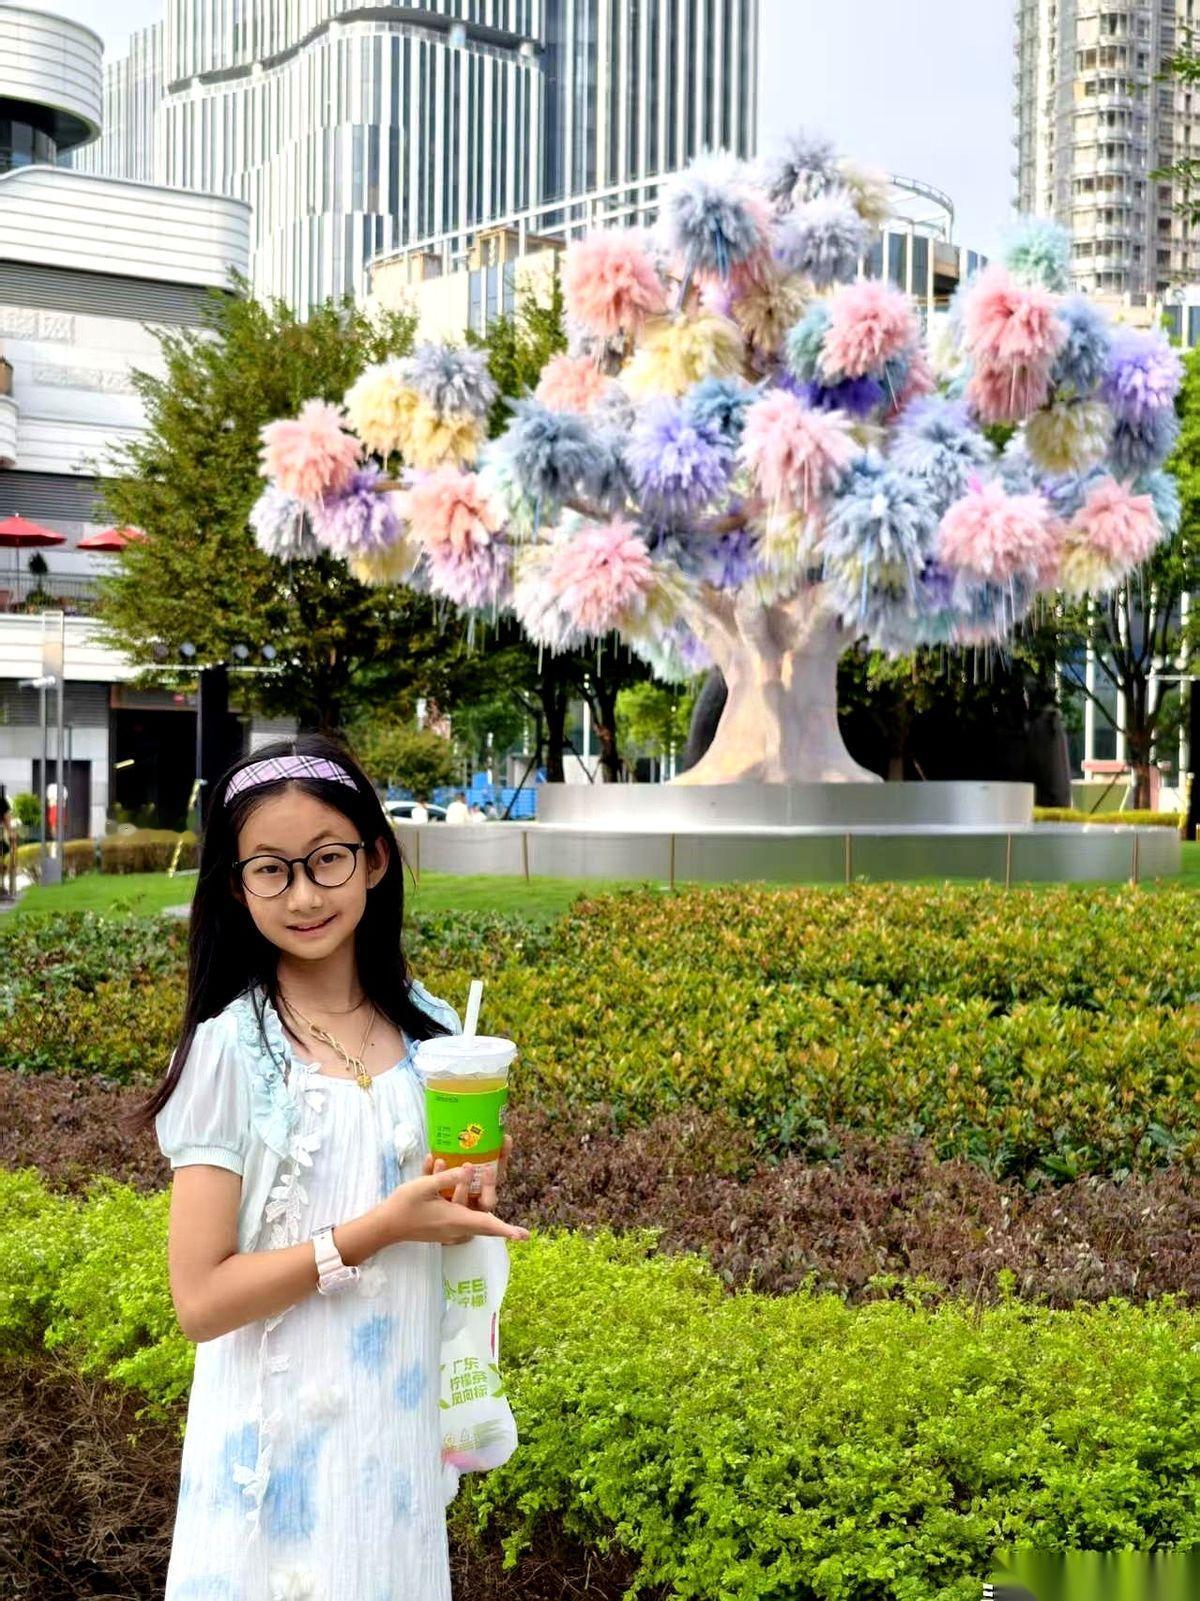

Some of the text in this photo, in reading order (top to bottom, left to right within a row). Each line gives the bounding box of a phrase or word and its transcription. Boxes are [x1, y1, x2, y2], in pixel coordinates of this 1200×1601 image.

[453, 1356, 479, 1374] 广东
[450, 1371, 488, 1391] 柠檬茶
[452, 1385, 488, 1407] 风向标
